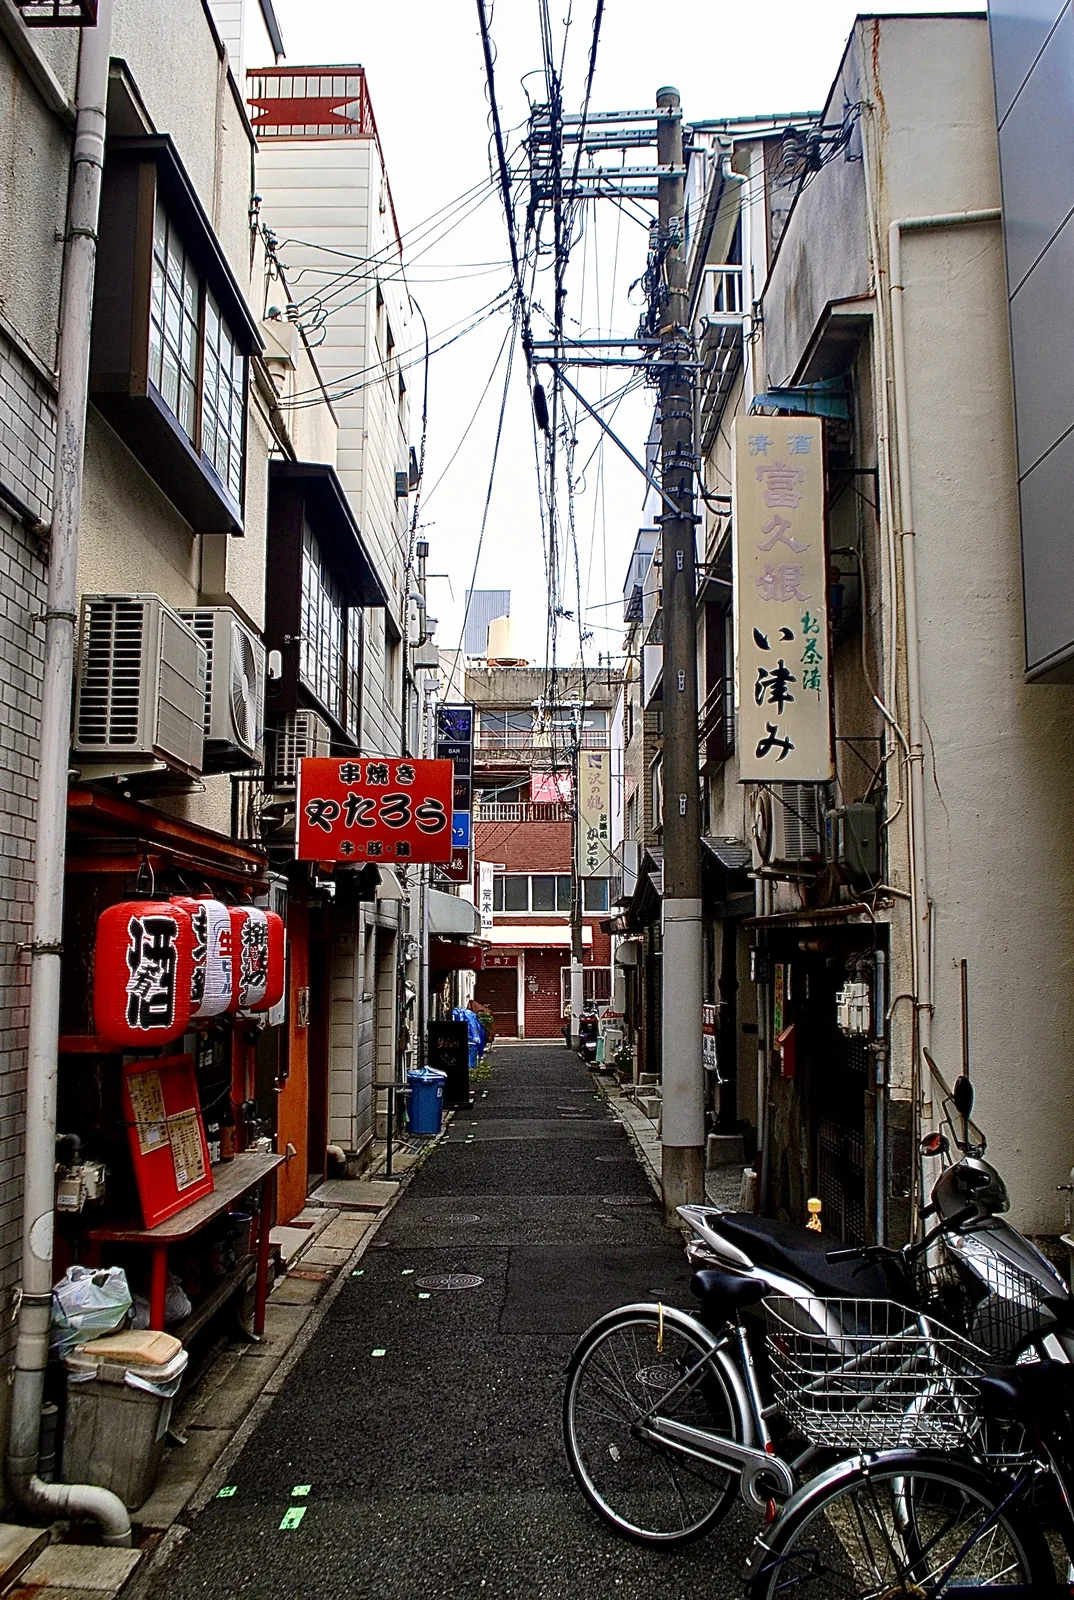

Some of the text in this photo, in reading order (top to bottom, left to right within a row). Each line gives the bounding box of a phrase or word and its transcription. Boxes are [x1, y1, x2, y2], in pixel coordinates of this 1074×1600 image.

[748, 432, 813, 457] 清酒
[752, 626, 797, 763] い津み
[338, 762, 416, 786] 串焼き
[586, 772, 606, 811] 沢の鶴
[304, 791, 448, 834] やたろう
